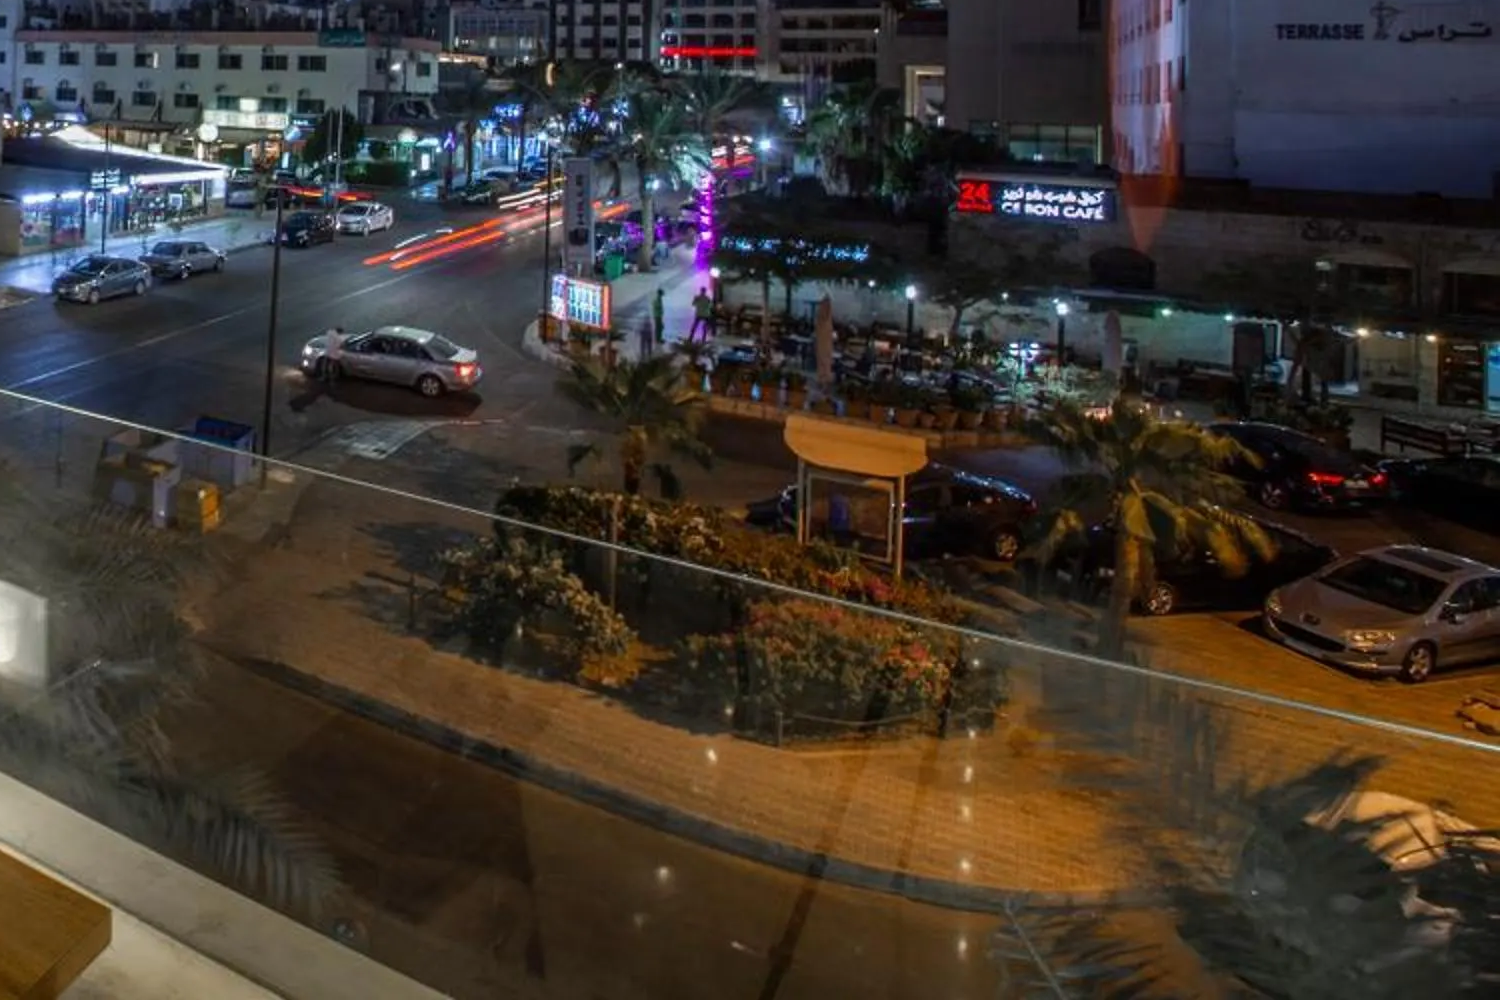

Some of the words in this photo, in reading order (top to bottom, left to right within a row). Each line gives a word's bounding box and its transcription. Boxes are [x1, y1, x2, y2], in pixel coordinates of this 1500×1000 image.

[1275, 23, 1365, 41] TERRASSE
[1397, 21, 1493, 43] تراس
[961, 183, 990, 201] 24
[1025, 203, 1059, 217] BON
